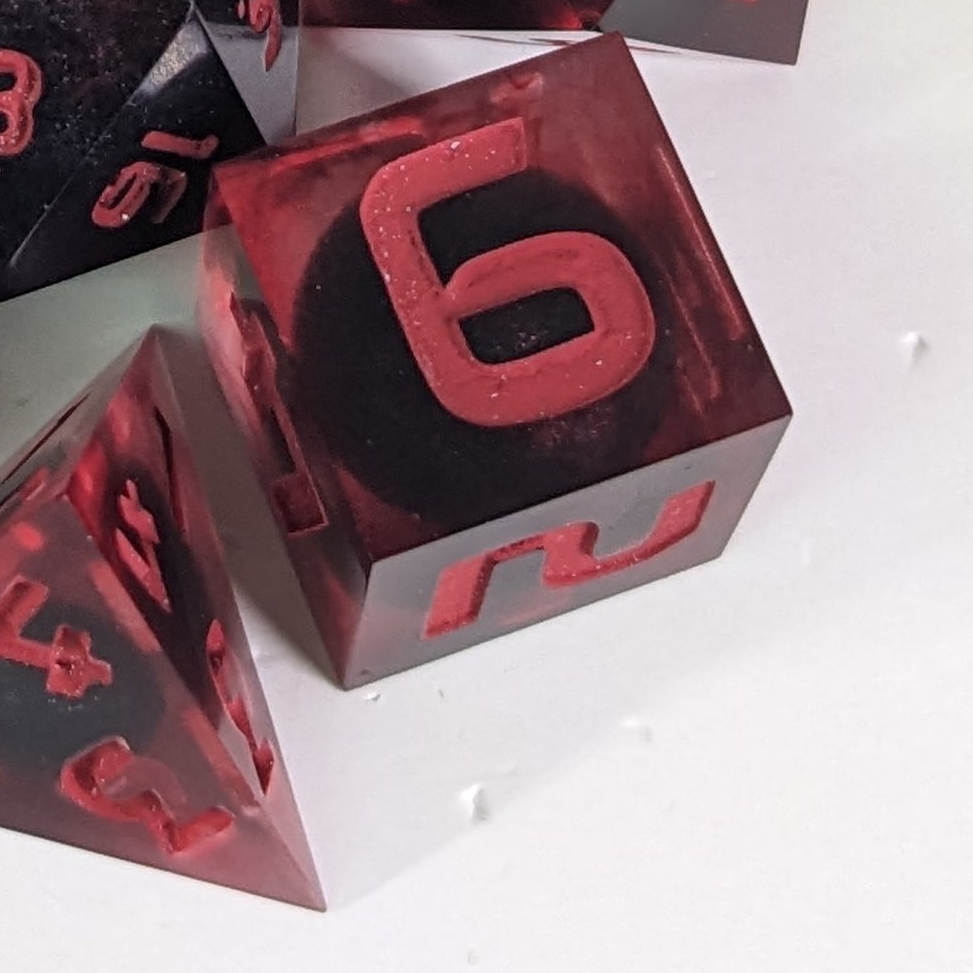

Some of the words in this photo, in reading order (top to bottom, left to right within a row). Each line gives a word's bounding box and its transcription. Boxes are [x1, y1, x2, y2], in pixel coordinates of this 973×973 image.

[91, 130, 219, 228] 16
[360, 117, 656, 427] 6
[422, 480, 715, 640] 2
